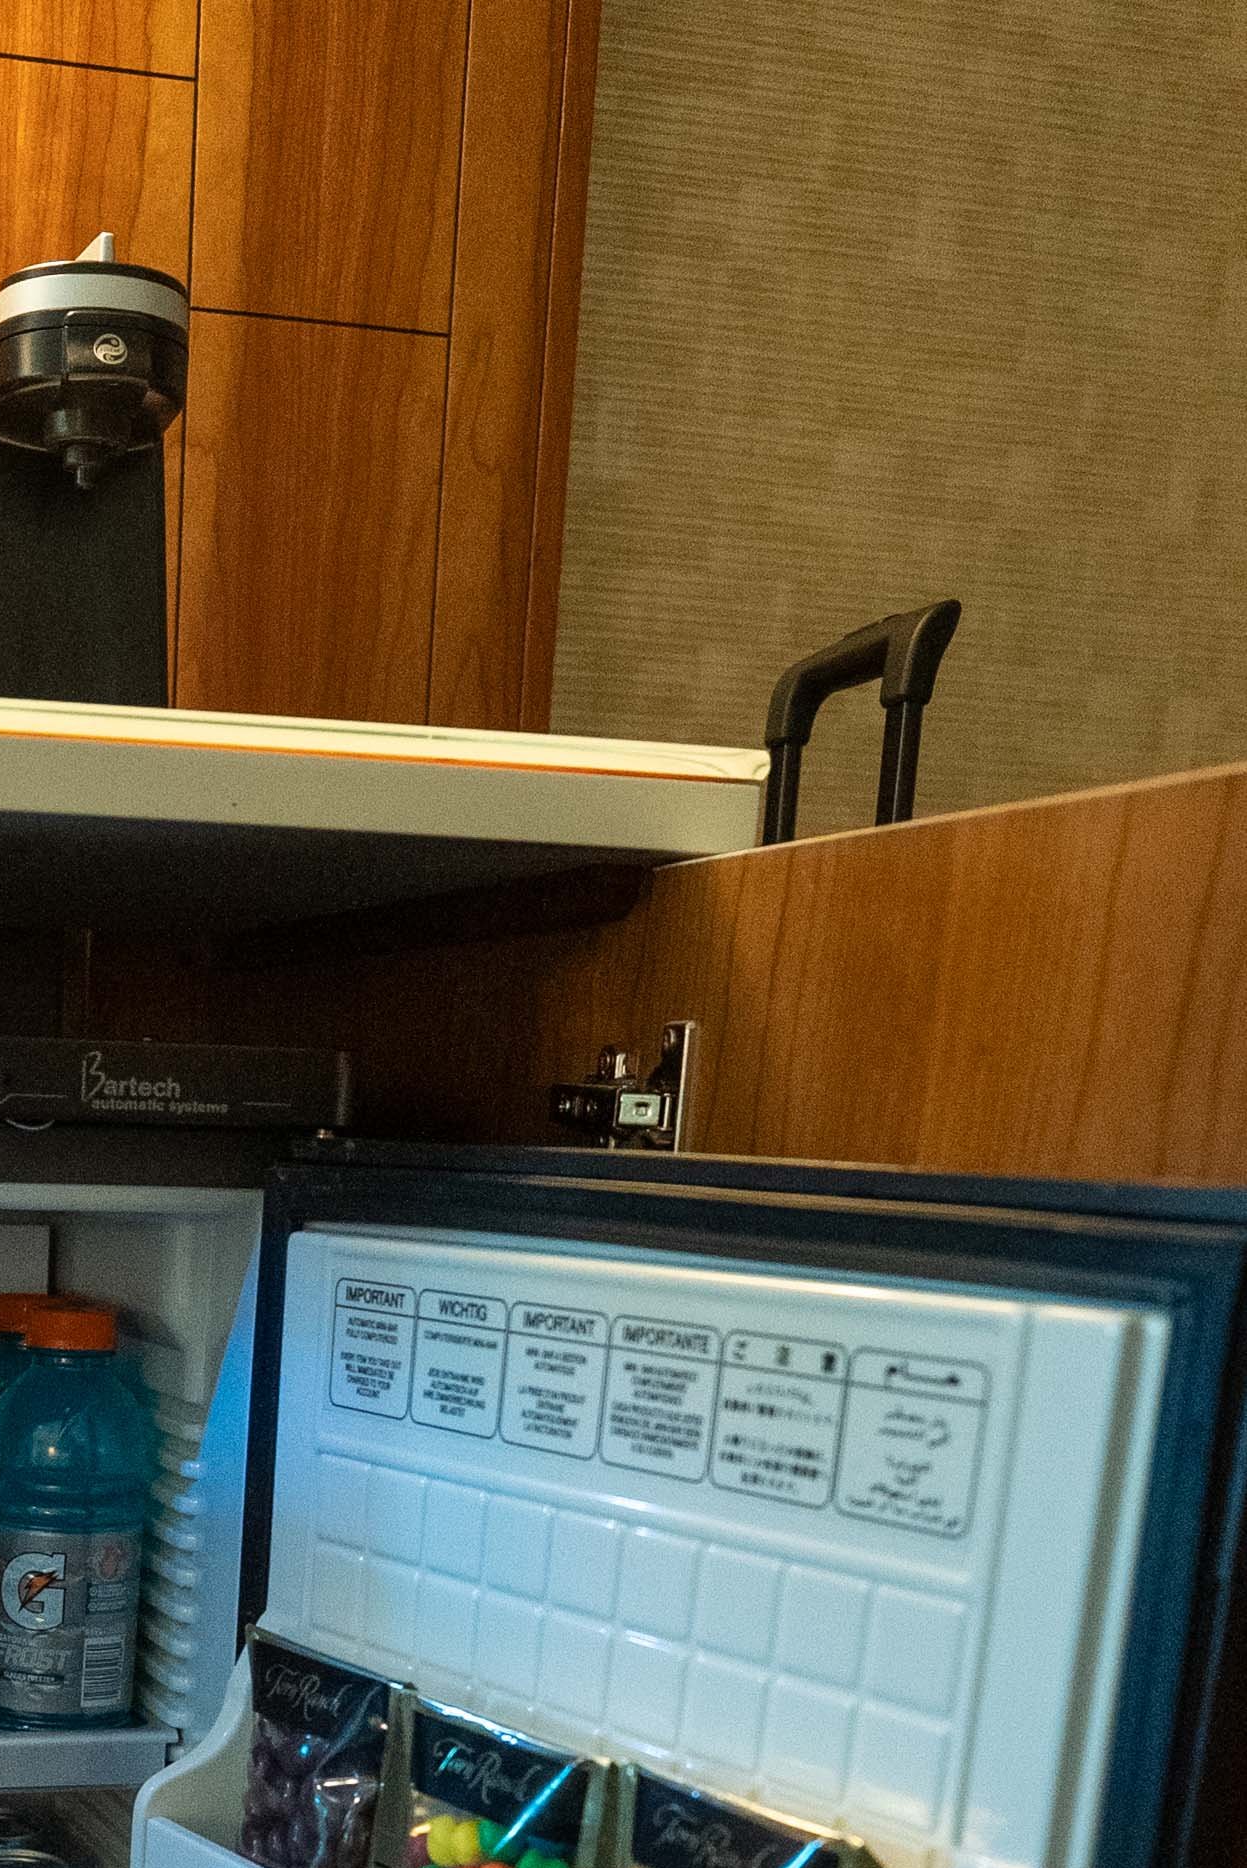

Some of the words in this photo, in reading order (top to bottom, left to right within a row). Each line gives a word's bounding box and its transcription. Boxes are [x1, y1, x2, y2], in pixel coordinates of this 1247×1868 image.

[80, 1050, 181, 1101] Bartech
[91, 1099, 165, 1112] automatic
[169, 1101, 229, 1115] systems
[345, 1286, 406, 1308] IMPORTANT
[439, 1299, 487, 1321] WICHTIG
[523, 1311, 594, 1335] IMPORTANT
